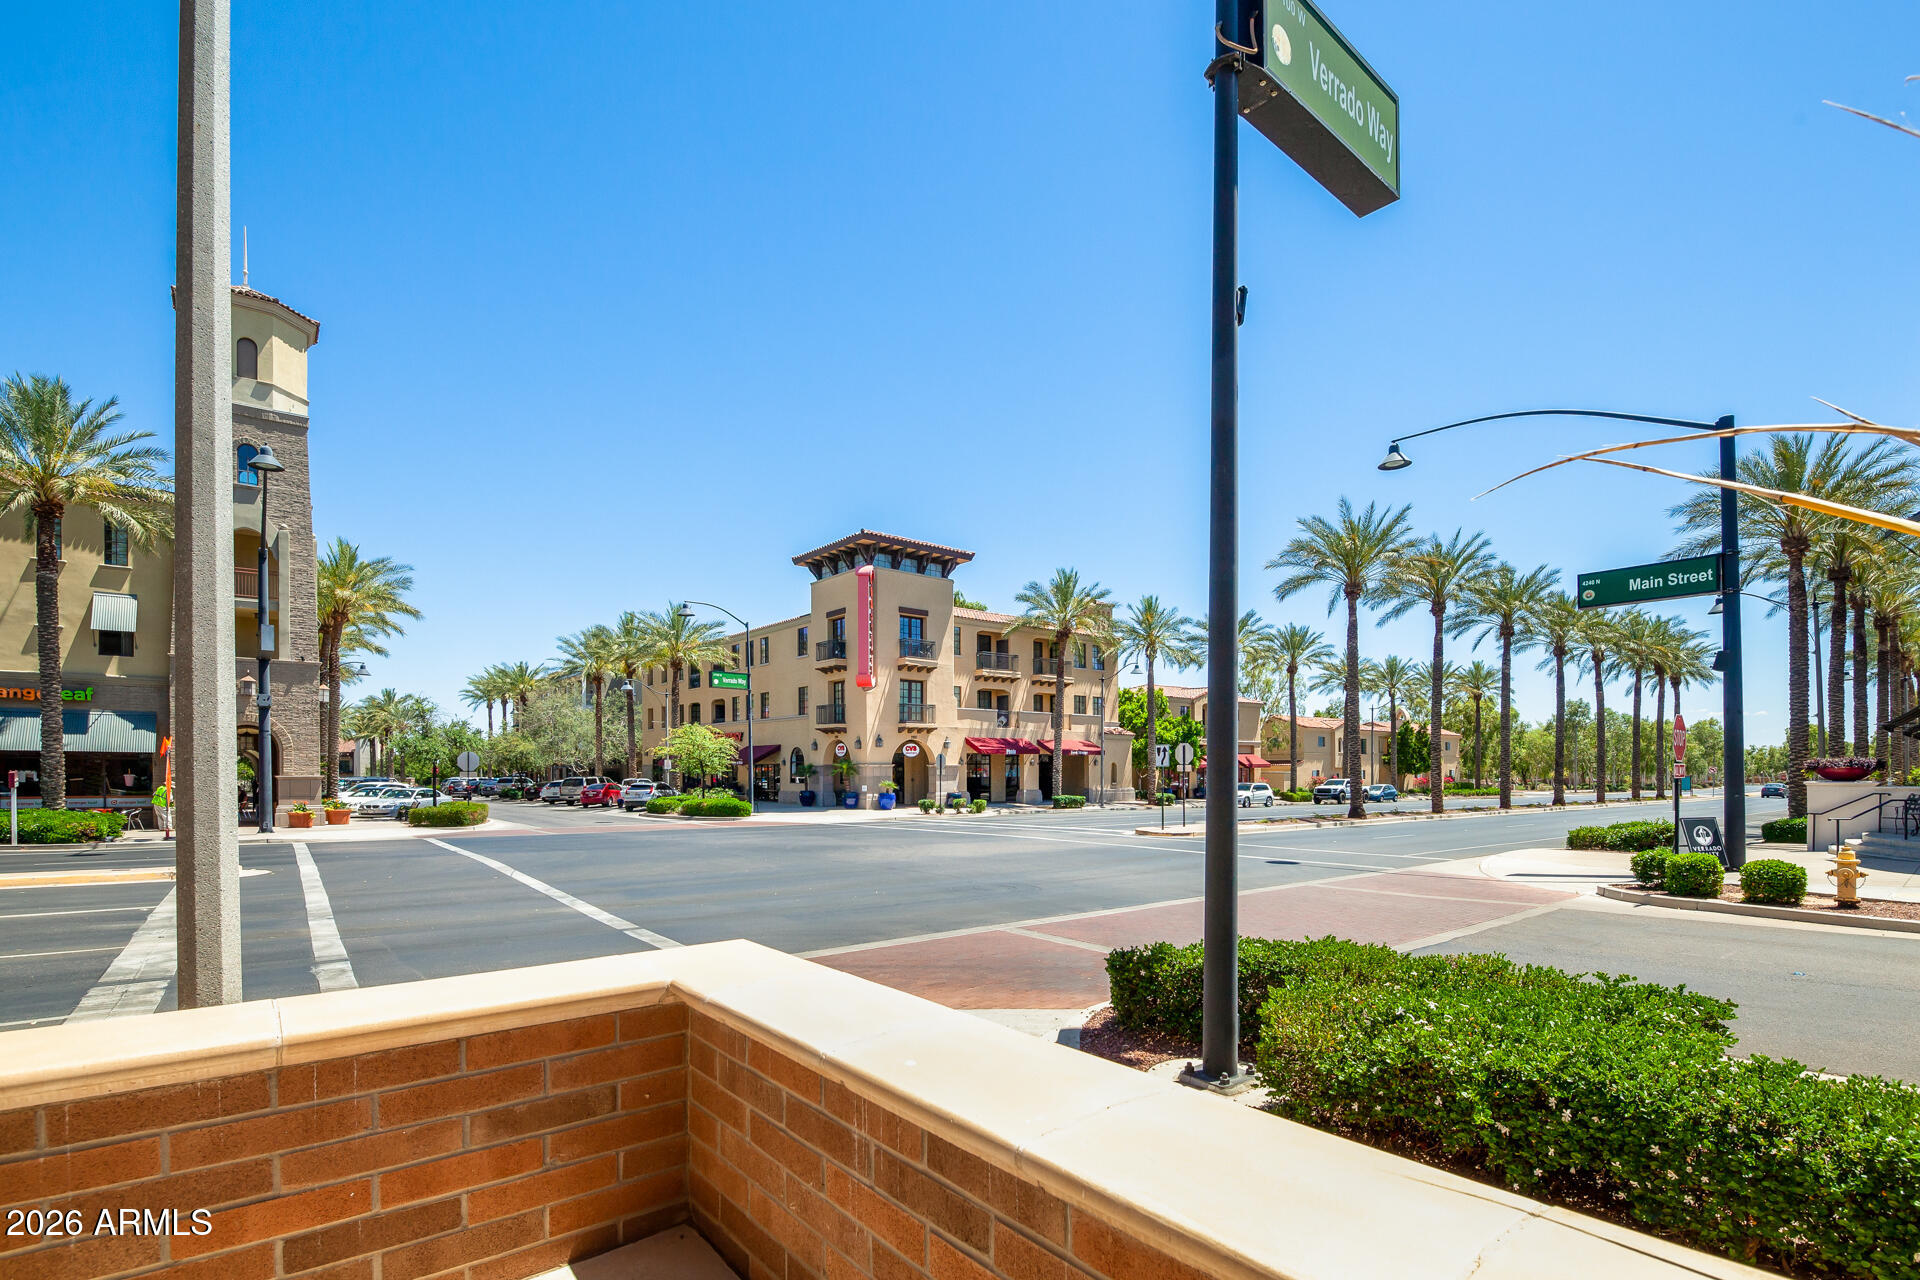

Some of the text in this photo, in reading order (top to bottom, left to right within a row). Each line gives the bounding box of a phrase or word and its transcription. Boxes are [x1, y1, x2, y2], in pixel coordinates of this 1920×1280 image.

[1298, 7, 1306, 27] W
[1309, 40, 1394, 164] Verrado Way
[1629, 568, 1713, 591] Main Street
[61, 687, 94, 701] eaf
[1674, 729, 1685, 747] STOP
